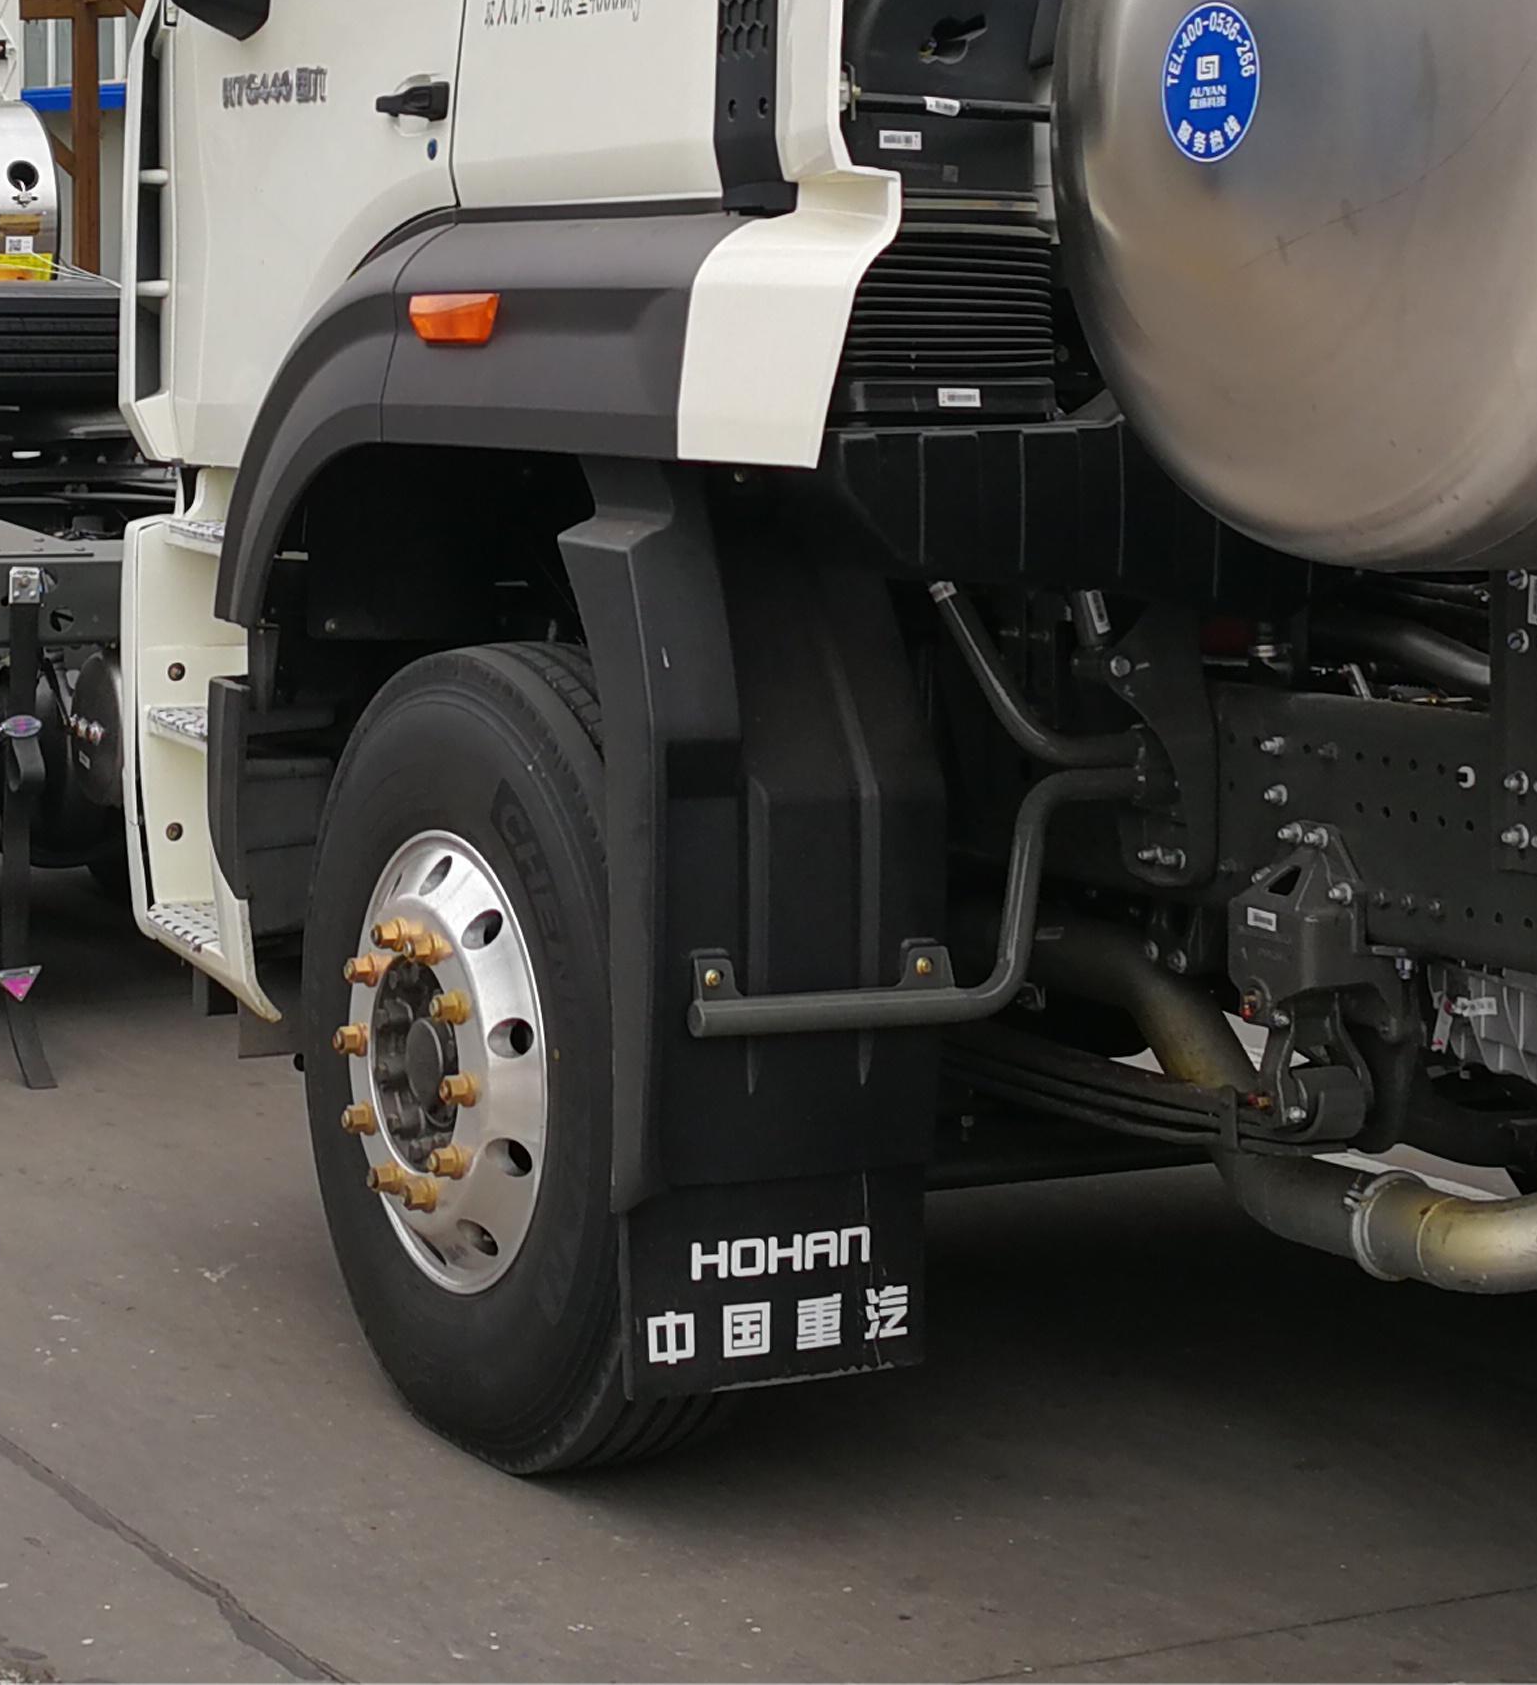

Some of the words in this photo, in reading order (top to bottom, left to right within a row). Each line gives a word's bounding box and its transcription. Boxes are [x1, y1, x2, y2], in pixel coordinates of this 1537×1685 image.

[690, 1225, 871, 1281] HOHAN
[646, 1284, 910, 1365] 中国重汽
